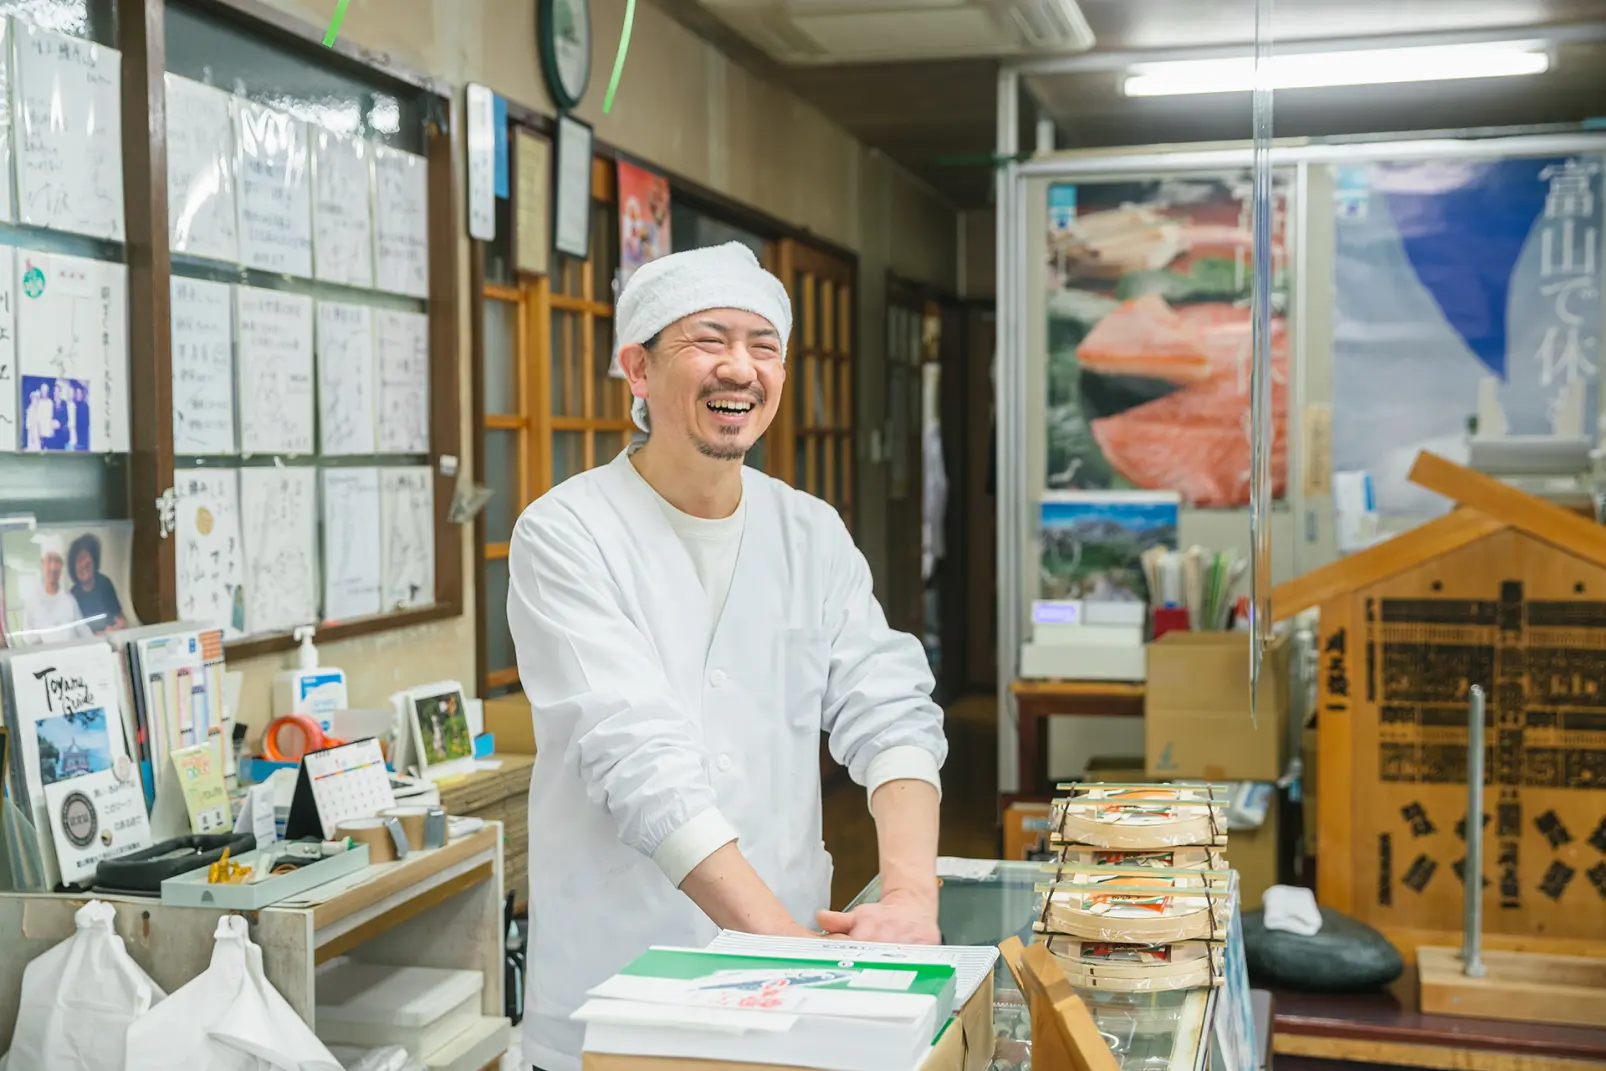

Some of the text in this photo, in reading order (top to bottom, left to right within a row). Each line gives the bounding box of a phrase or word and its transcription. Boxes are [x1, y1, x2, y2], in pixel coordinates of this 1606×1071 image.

[1535, 158, 1600, 430] 富山で休
[32, 667, 84, 712] Toyama
[61, 684, 95, 716] Guide
